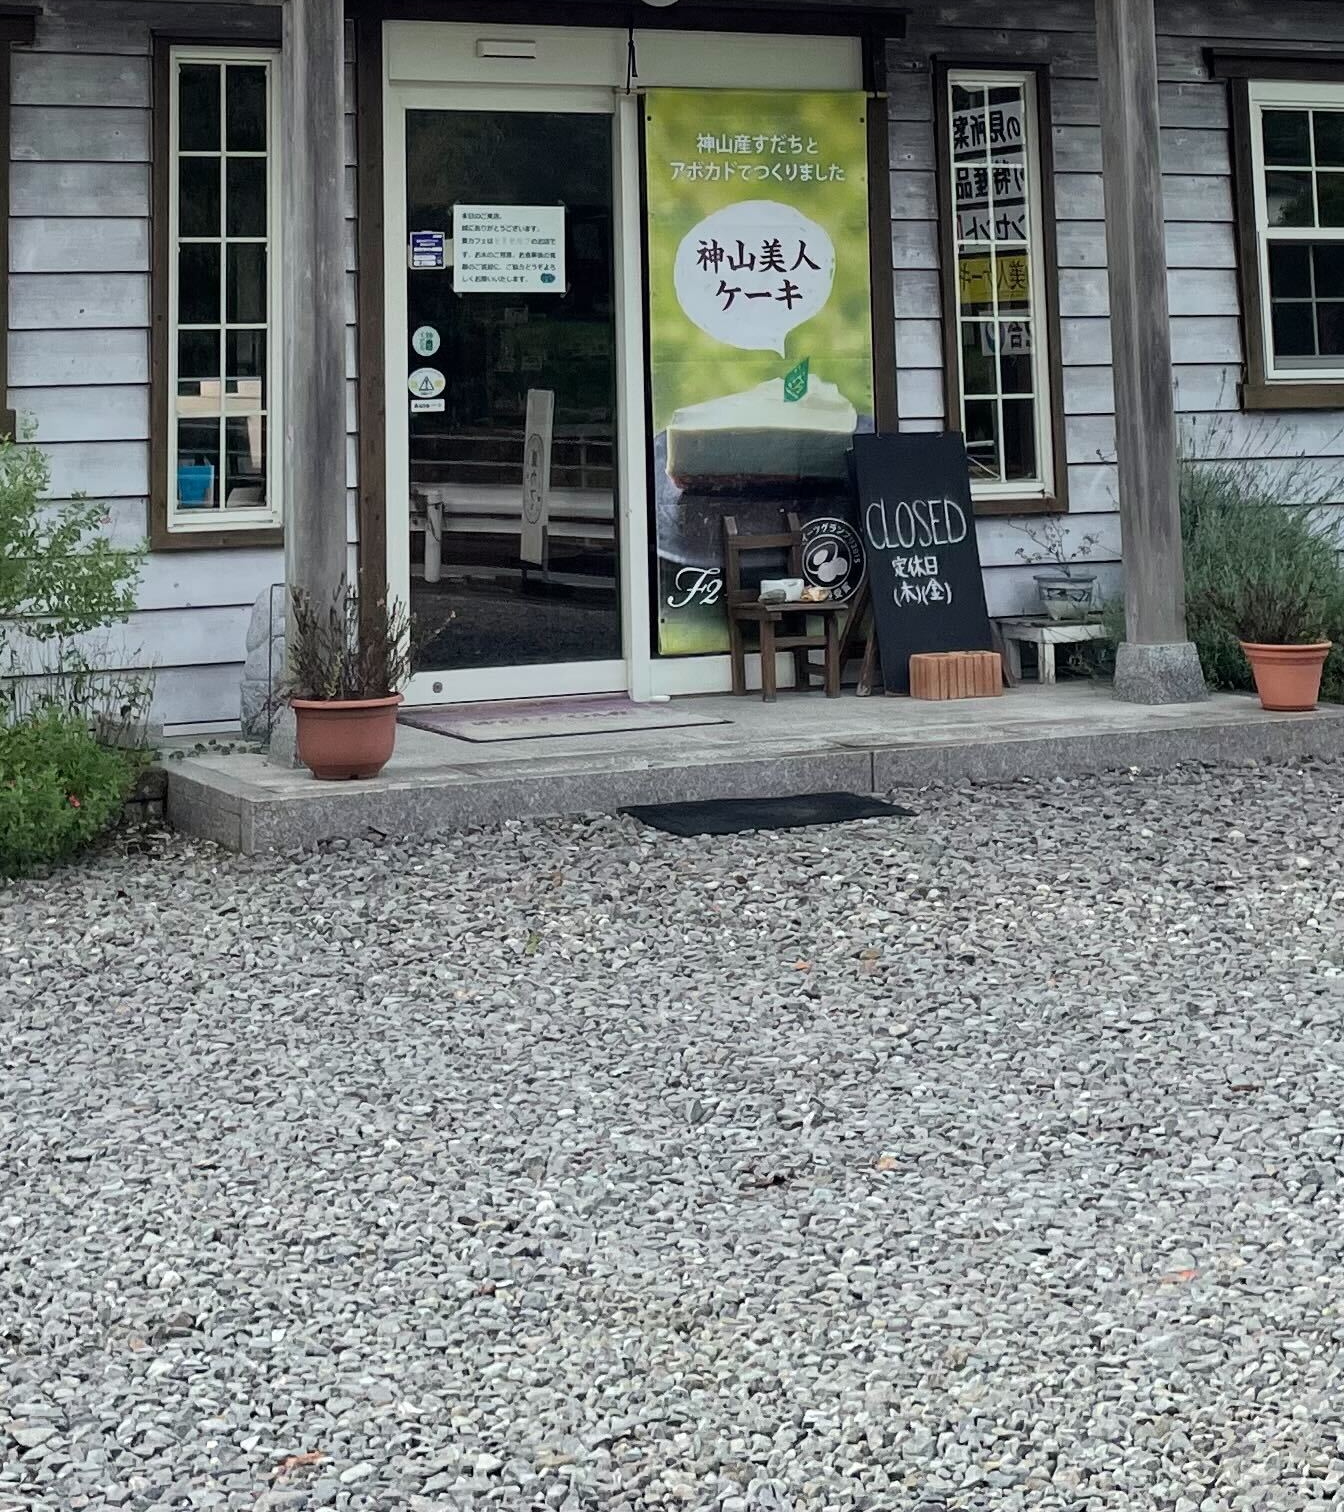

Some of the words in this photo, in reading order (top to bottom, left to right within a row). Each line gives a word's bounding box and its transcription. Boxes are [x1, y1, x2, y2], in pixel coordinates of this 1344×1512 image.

[696, 133, 819, 154] 神山産すだちと
[670, 162, 846, 182] アボカドでつくりました
[696, 238, 822, 274] 神山美人
[715, 279, 804, 311] ケーキ
[865, 497, 967, 550] CLOSED
[891, 554, 938, 578] 定休日
